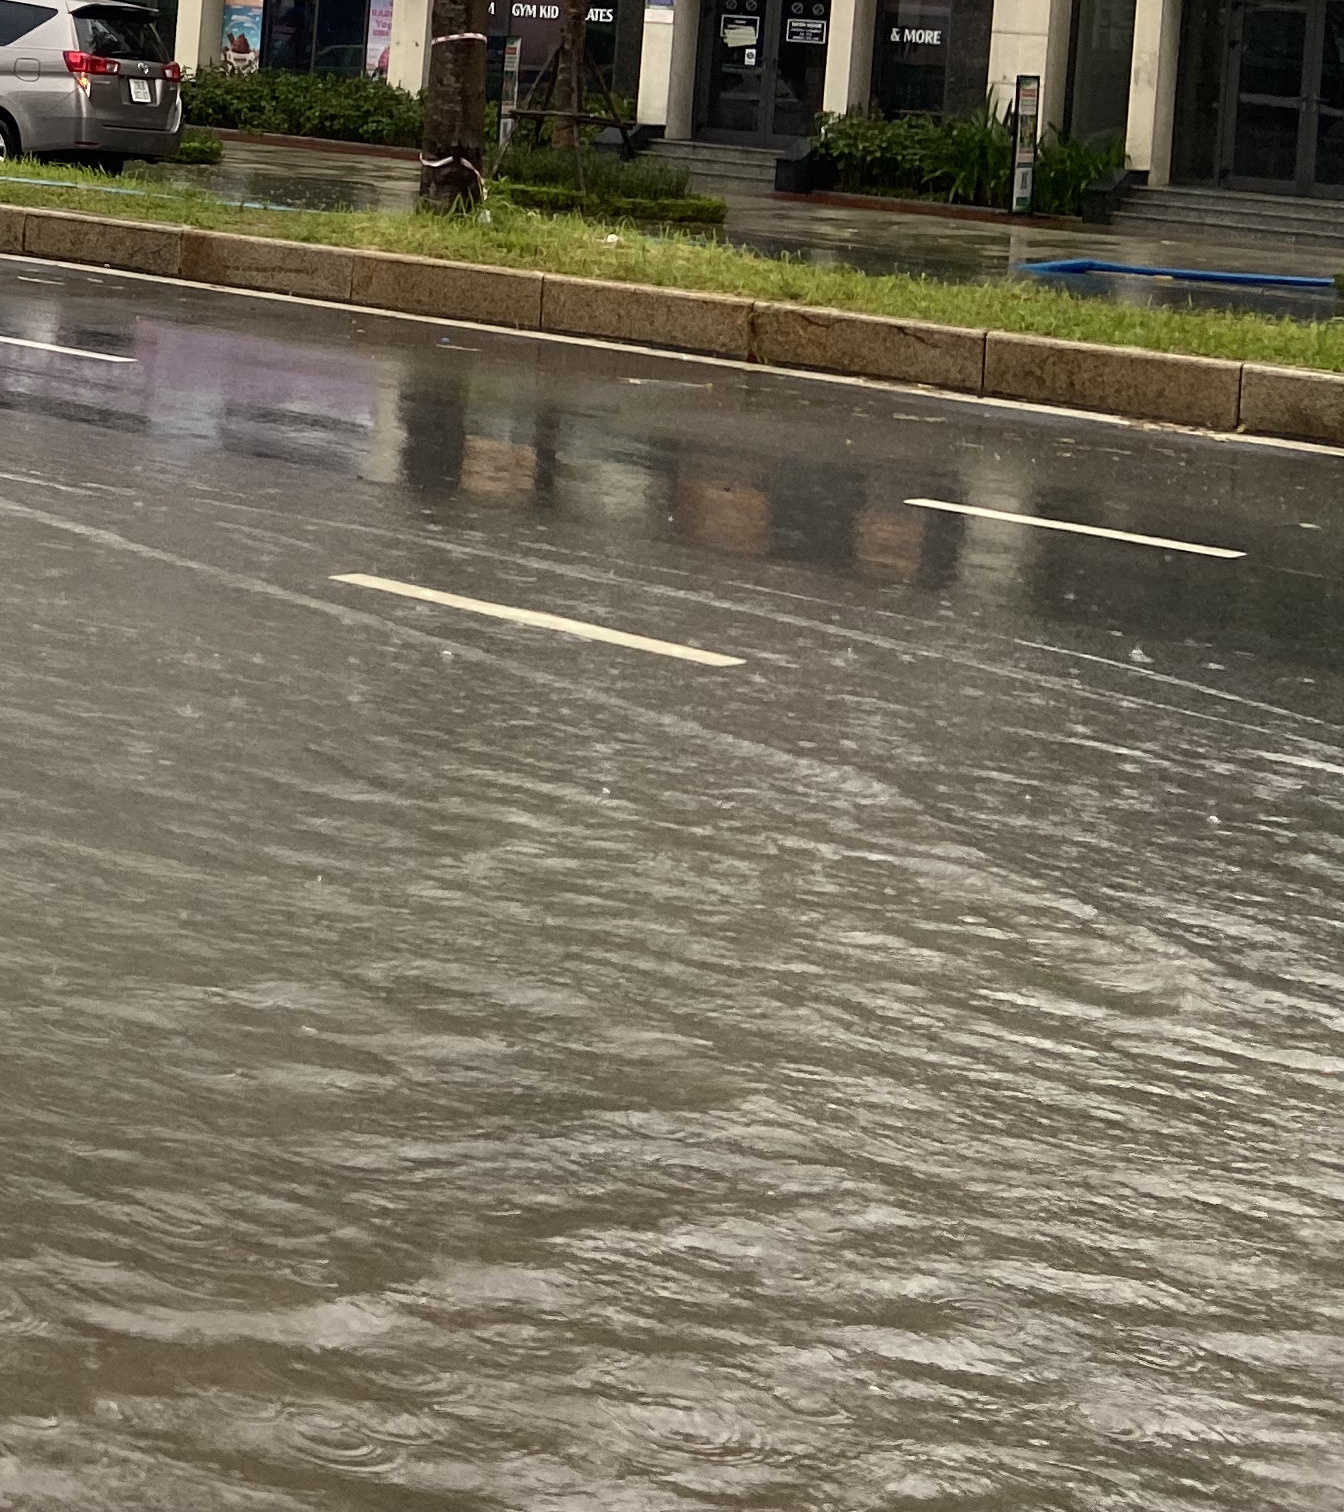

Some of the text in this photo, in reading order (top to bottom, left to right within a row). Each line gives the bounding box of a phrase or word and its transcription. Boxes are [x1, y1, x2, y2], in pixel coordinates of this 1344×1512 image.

[511, 2, 537, 19] GYM
[539, 4, 560, 20] KID
[890, 28, 943, 46] & MORE
